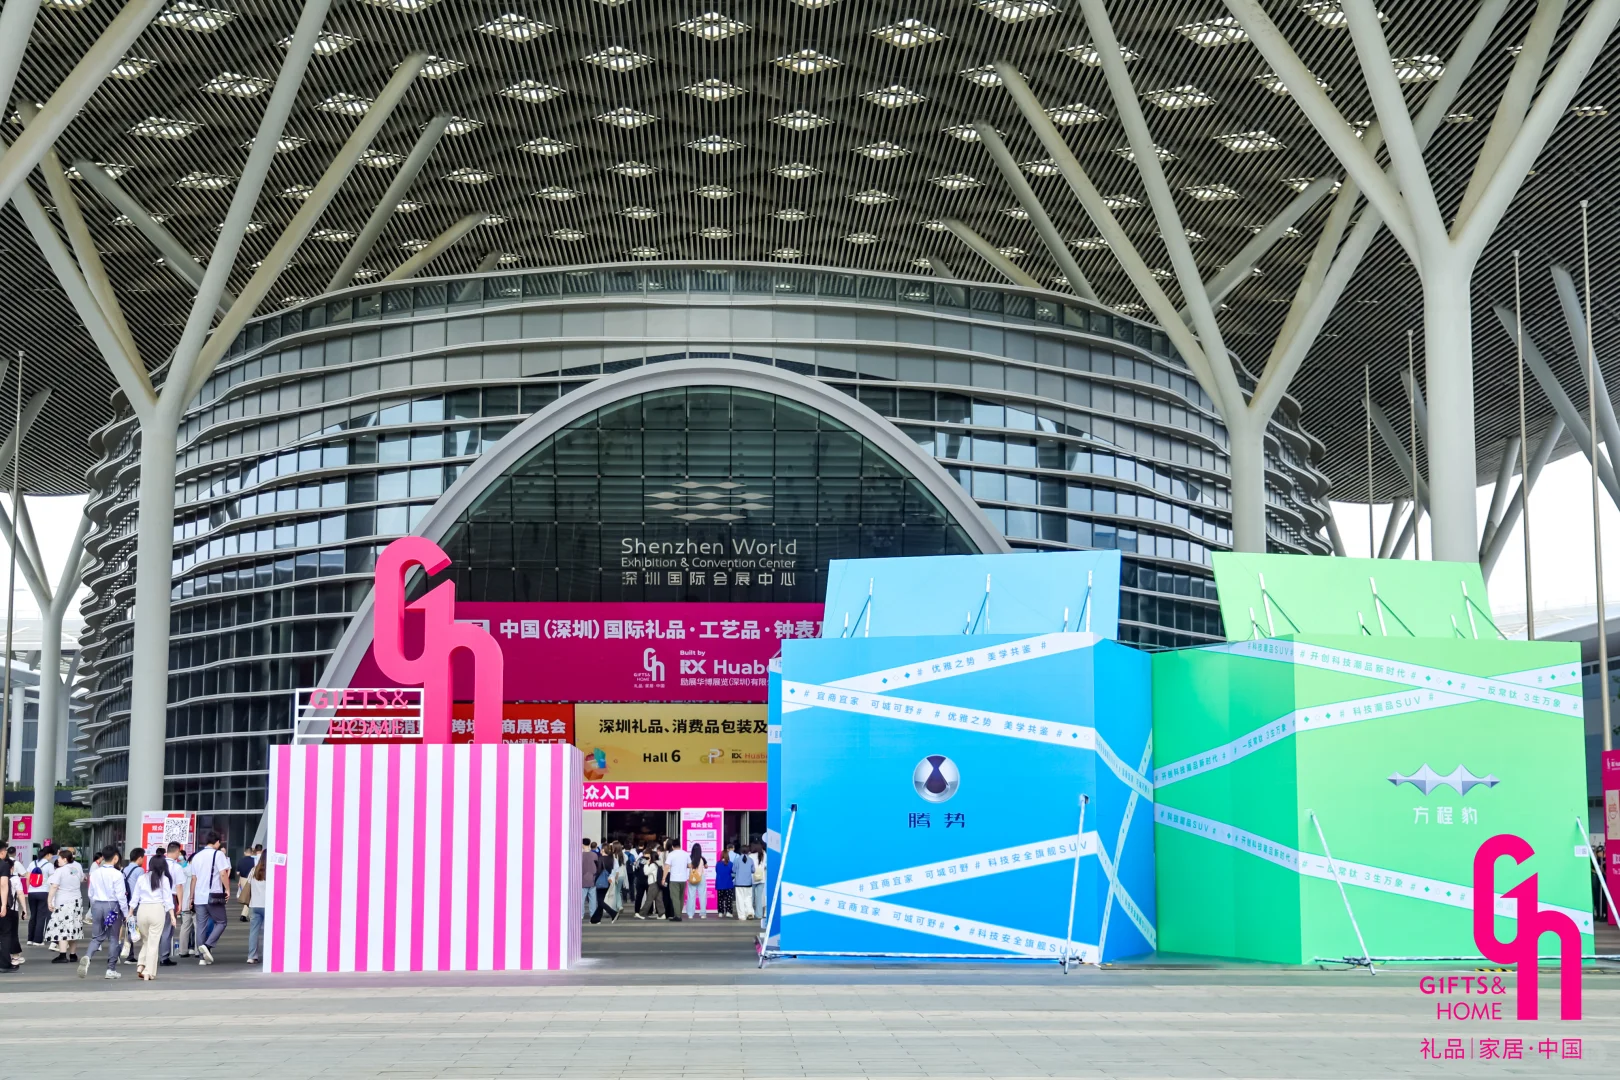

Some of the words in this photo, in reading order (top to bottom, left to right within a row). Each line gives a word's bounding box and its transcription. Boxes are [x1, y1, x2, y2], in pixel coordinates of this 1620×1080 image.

[622, 538, 724, 555] Shenzhen
[732, 538, 797, 555] World
[622, 557, 677, 568] Exhibition
[680, 557, 689, 568] &
[692, 557, 756, 568] Convention
[759, 557, 796, 568] Center
[622, 571, 796, 586] 深圳国际会展中心
[328, 717, 404, 739] HOME
[643, 752, 668, 763] Hall
[671, 749, 681, 763] 6
[583, 784, 629, 800] 众入口
[583, 800, 615, 808] Entrance
[1413, 806, 1479, 826] 方程豹
